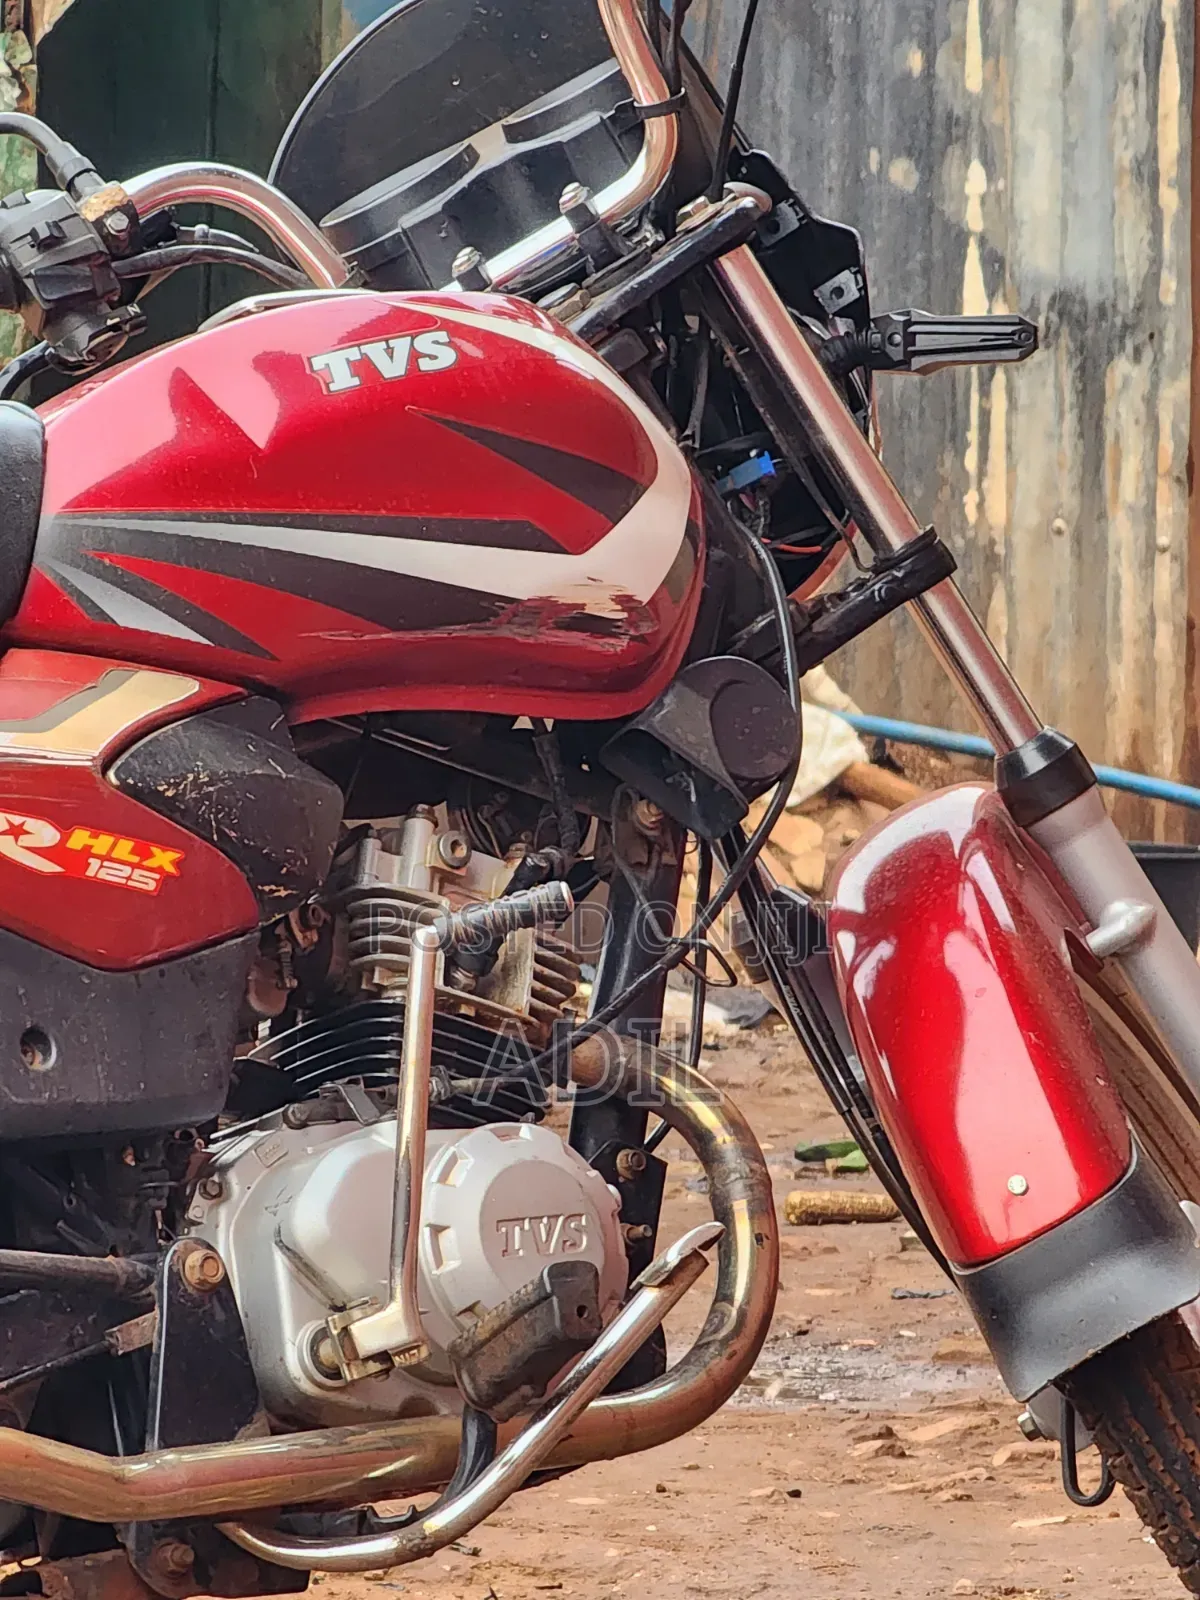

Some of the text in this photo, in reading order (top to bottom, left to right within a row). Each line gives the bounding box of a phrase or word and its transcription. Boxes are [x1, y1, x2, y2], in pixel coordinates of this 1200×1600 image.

[310, 330, 458, 393] TVS
[65, 828, 183, 875] HLX
[84, 857, 161, 892] 125
[496, 1212, 588, 1258] TVS
